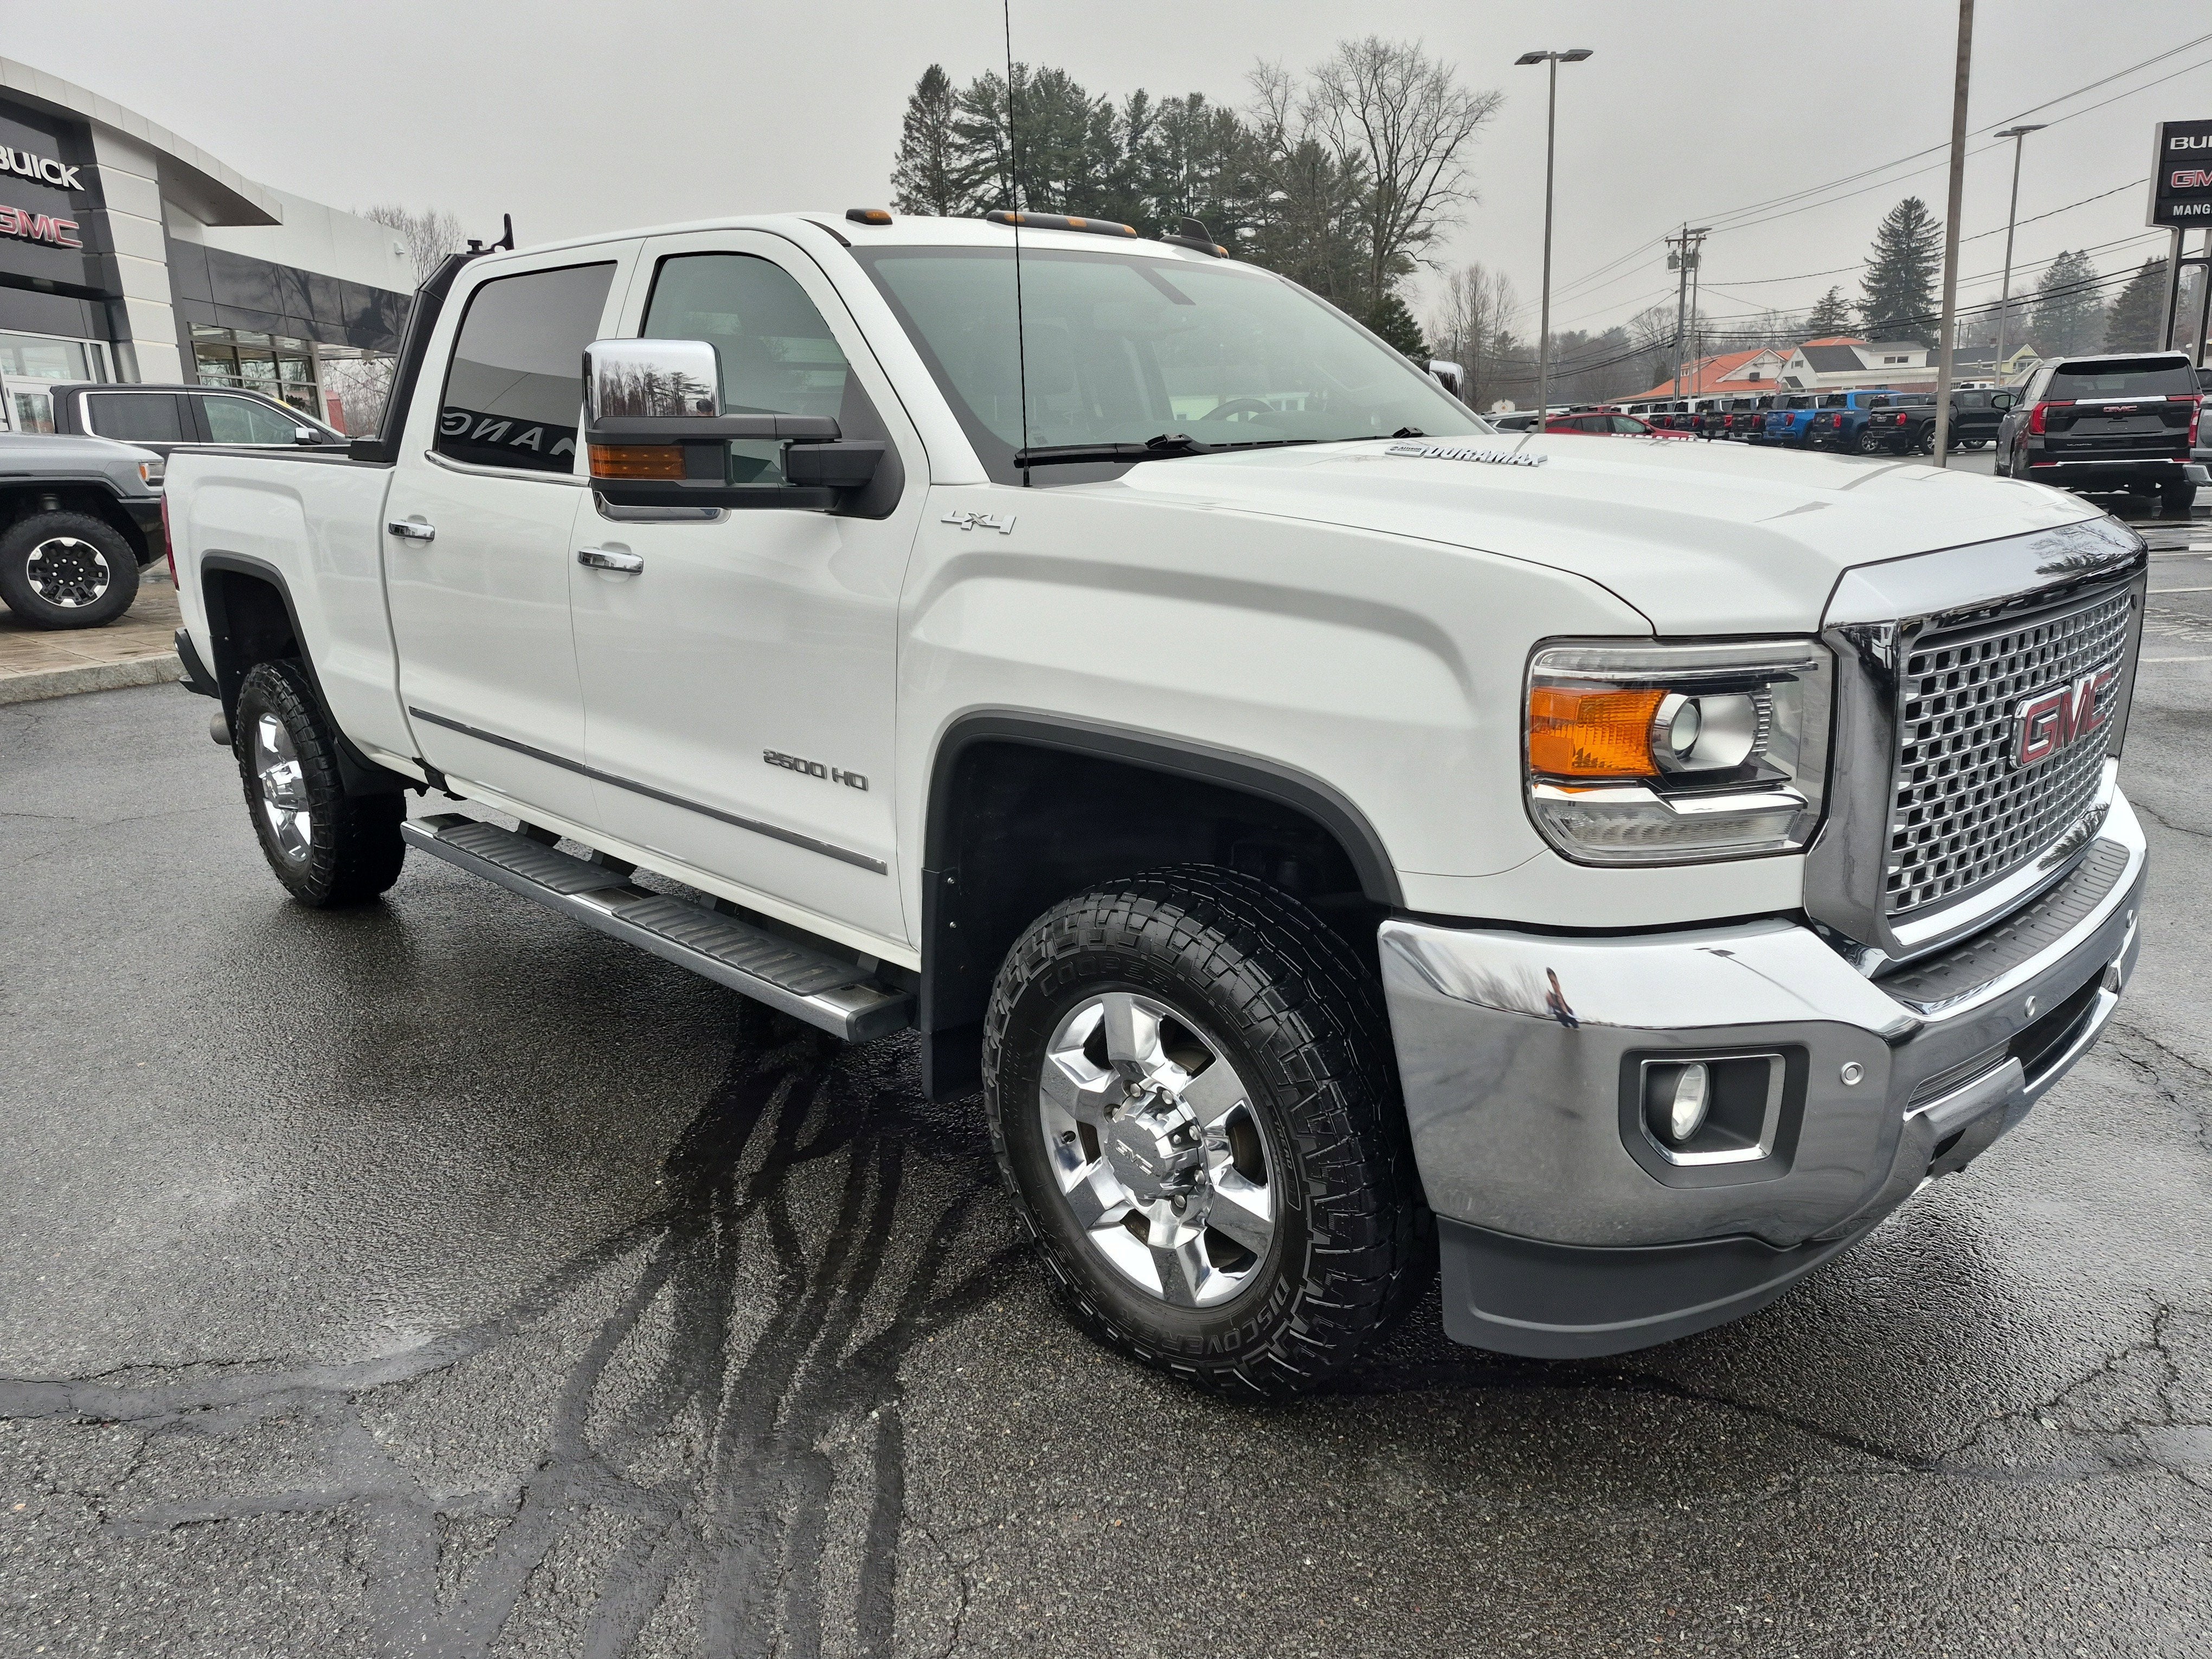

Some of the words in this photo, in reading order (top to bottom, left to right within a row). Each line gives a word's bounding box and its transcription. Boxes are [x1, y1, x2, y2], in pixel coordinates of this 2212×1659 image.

[2173, 203, 2212, 216] MANG
[1423, 446, 1547, 467] DURAMAX
[2011, 665, 2114, 769] GMC
[763, 749, 827, 780] 2500
[832, 766, 869, 792] HD
[1039, 956, 1171, 996] COOPER
[1116, 1139, 1153, 1175] GMC
[1116, 1273, 1290, 1354] DISCOVERER
